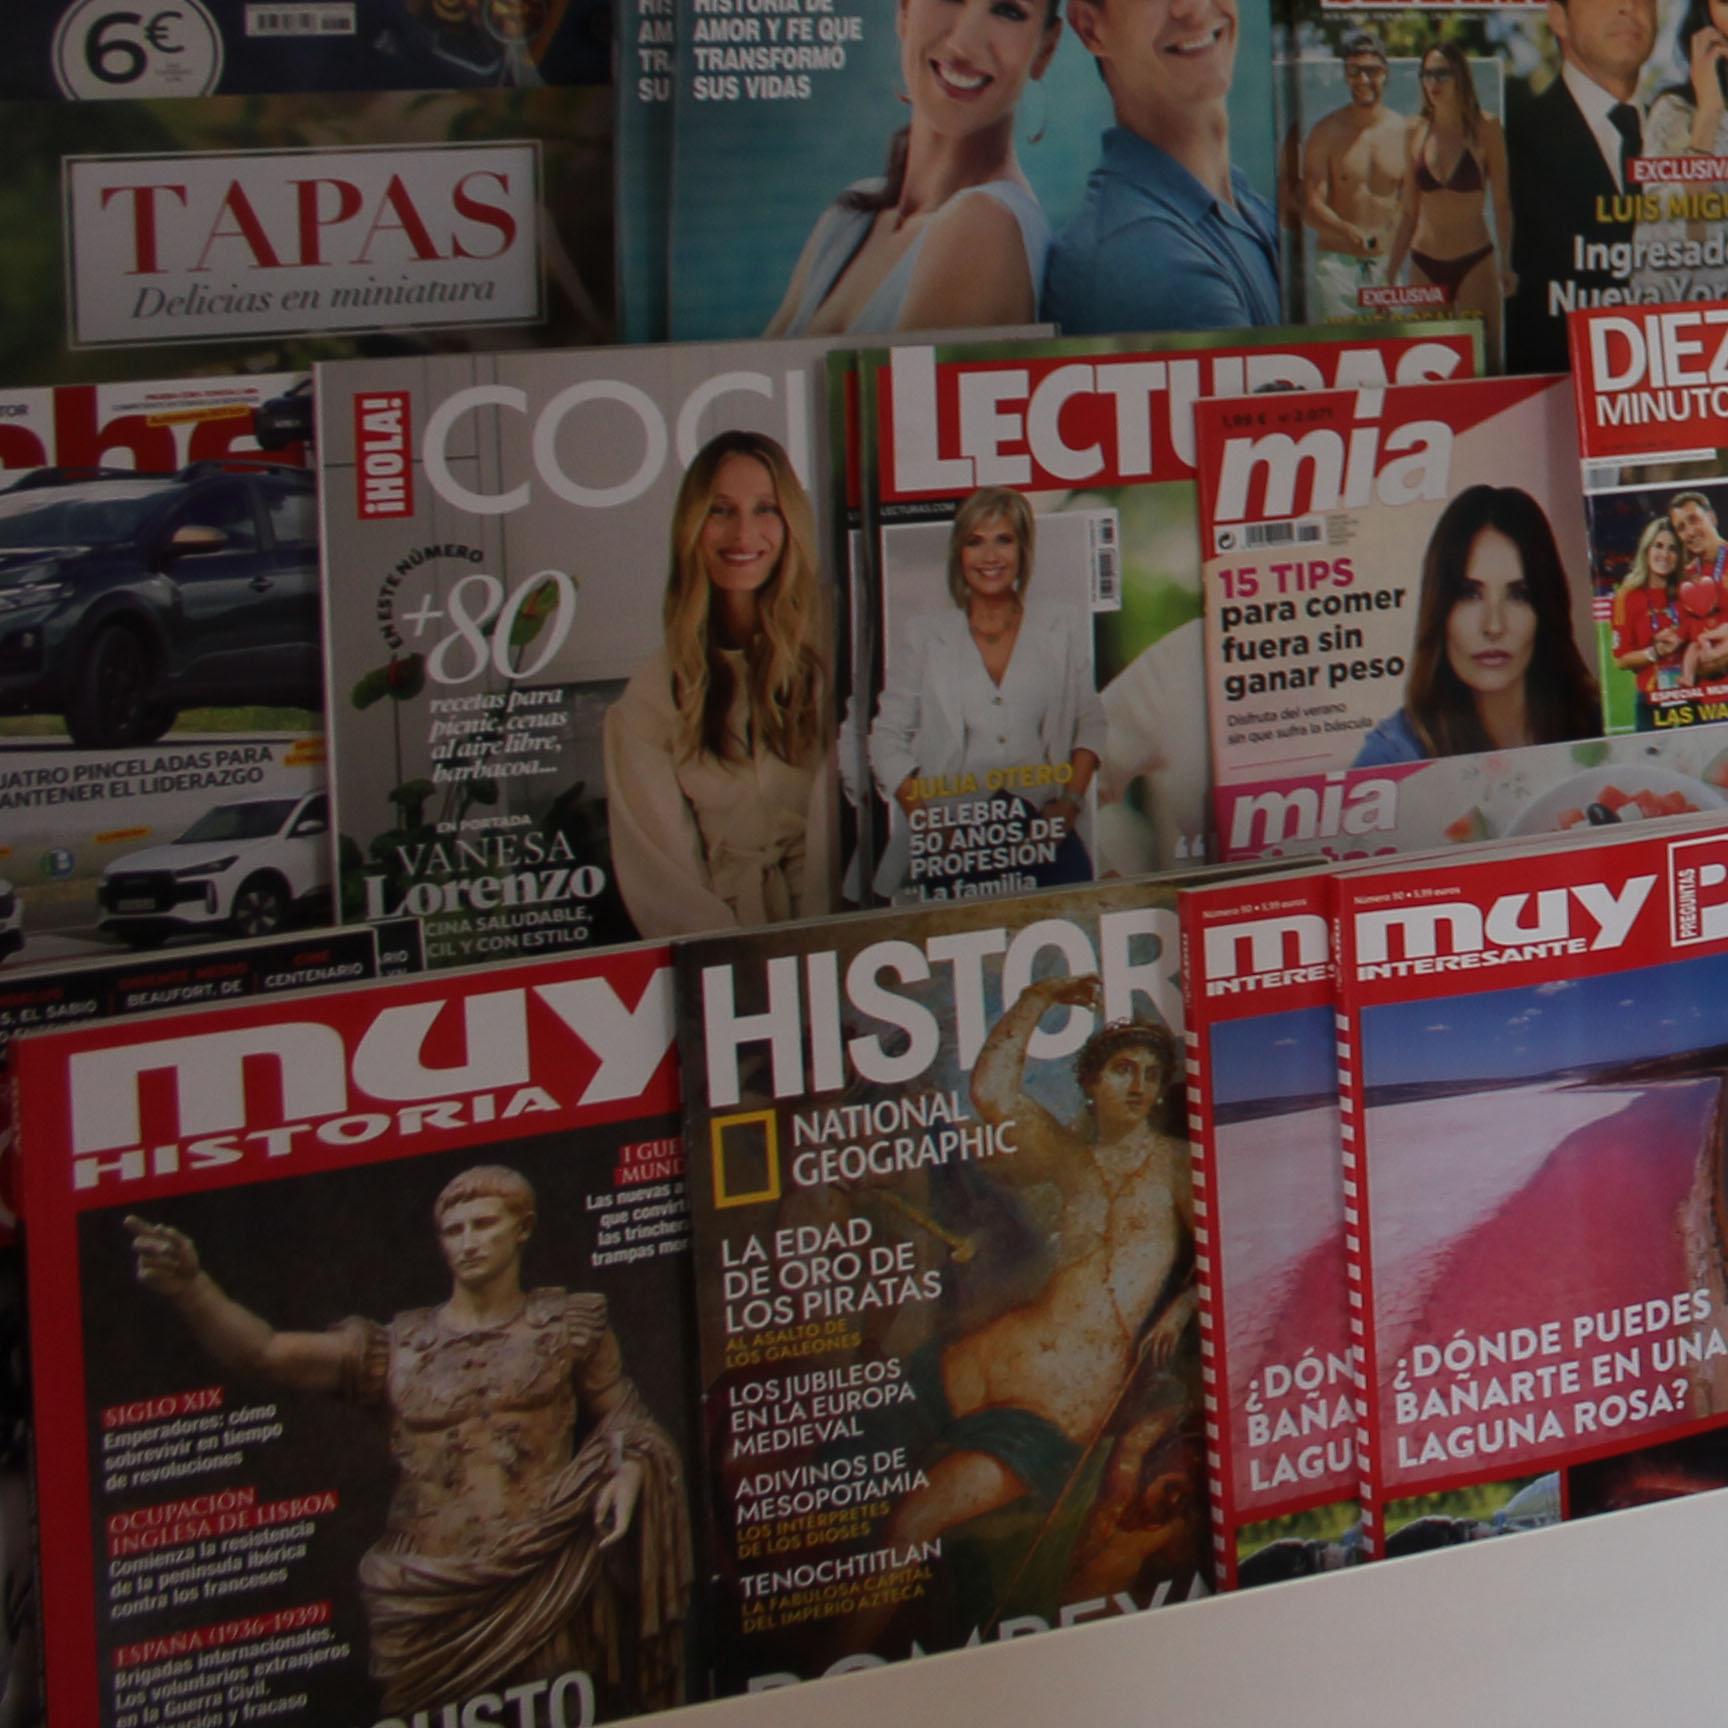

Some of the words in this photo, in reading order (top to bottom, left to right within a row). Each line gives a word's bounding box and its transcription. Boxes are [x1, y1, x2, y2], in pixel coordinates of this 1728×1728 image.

[85, 9, 186, 84] 6€
[693, 18, 761, 42] AMOR
[765, 18, 782, 41] Y
[787, 18, 814, 40] FE
[818, 17, 863, 43] QUE
[693, 43, 846, 70] TRANSFORMÓ
[693, 76, 739, 99] SUS
[744, 75, 811, 99] VIDAS
[100, 170, 517, 275] TAPAS
[1596, 194, 1660, 222] LUIS
[130, 279, 274, 320] Delicias
[279, 282, 321, 309] en
[330, 275, 496, 308] miniatura
[363, 397, 408, 514] ¡HOLA!
[1213, 387, 1456, 524] mia
[1219, 568, 1259, 598] 15
[1276, 558, 1355, 595] TIPS
[402, 567, 579, 688] +80
[1220, 597, 1300, 634] para
[1306, 587, 1406, 621] comer
[1221, 632, 1310, 665] fuera
[1317, 626, 1365, 655] sin
[1224, 666, 1320, 703] ganar
[1327, 655, 1406, 692] peso
[1653, 704, 1694, 728] LAS
[74, 753, 211, 786] PINCELADAS
[216, 745, 274, 770] PARA
[106, 782, 135, 803] EL
[139, 766, 266, 801] LIDERAZGO
[909, 798, 1026, 832] CELEBRA
[909, 830, 945, 856] 50
[950, 823, 1024, 851] AÑOS
[1029, 818, 1066, 842] DE
[397, 830, 576, 878] VANESA
[909, 841, 1057, 880] PROFESIÓN
[364, 866, 606, 924] Lorenzo
[1356, 938, 1588, 982] INTERESANTE
[73, 1085, 564, 1193] HISTORIA
[790, 1089, 969, 1149] NATIONAL
[790, 1118, 1019, 1189] GEOGRAPHIC
[721, 1234, 768, 1268] LA
[774, 1216, 873, 1260] EDAD
[723, 1265, 771, 1302] DE
[778, 1253, 862, 1292] ORO
[868, 1240, 916, 1276] DE
[725, 1295, 795, 1335] LOS
[802, 1270, 943, 1320] PIRATAS
[1392, 1314, 1562, 1392] ¿DÓNDE
[1572, 1288, 1714, 1348] PUEDES
[1395, 1360, 1588, 1426] BAÑARTE
[1591, 1344, 1641, 1387] EN
[1396, 1414, 1565, 1470] LAGUNA
[1574, 1377, 1691, 1434] ROSA?
[738, 1537, 943, 1600] TENOCHTITLAN
